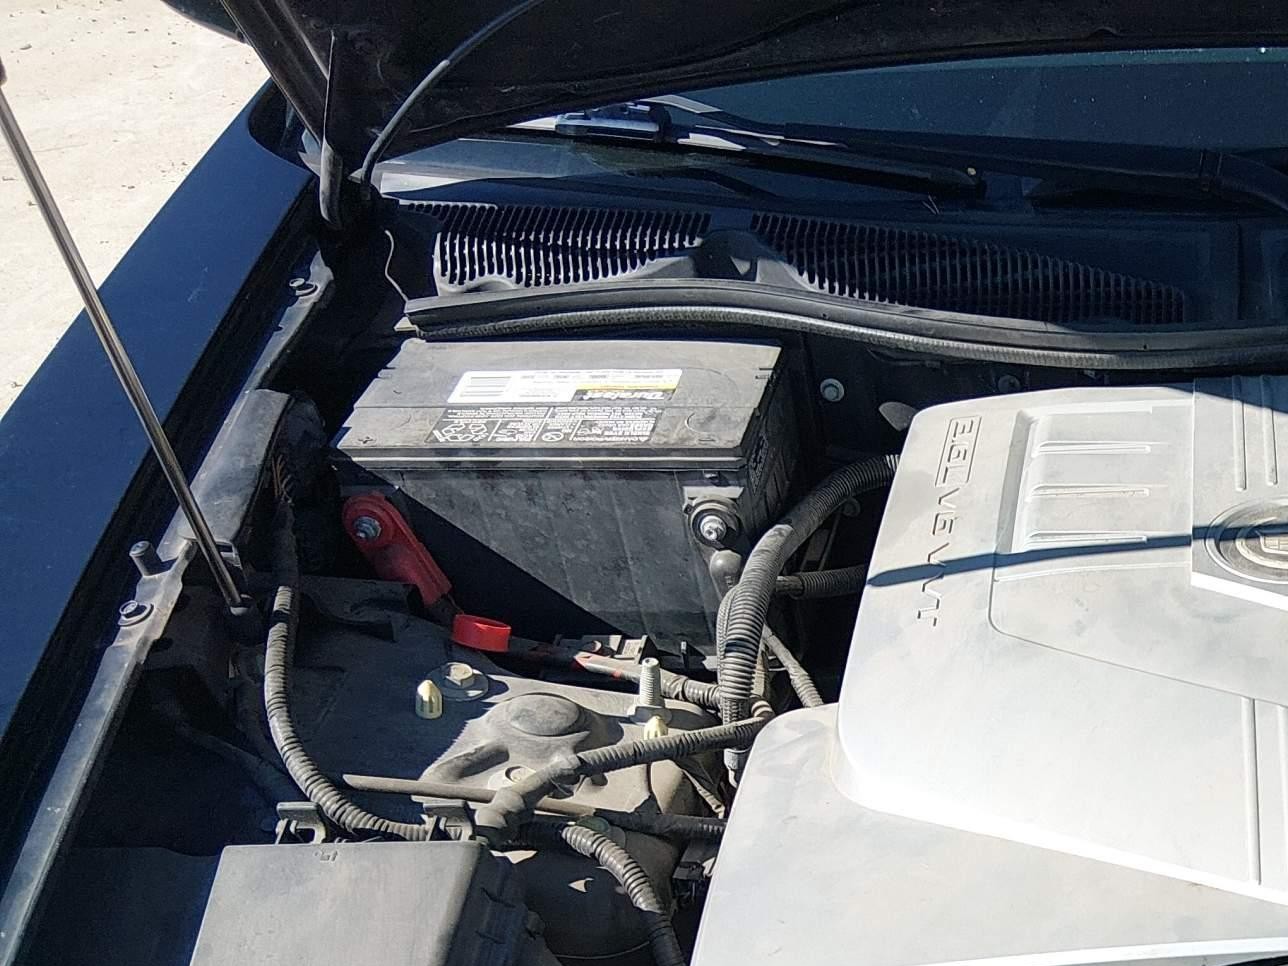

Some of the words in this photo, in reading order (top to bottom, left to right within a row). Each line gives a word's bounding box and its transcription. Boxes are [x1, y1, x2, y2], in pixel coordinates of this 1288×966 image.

[942, 419, 974, 485] 3.6L
[931, 487, 961, 537] V6
[916, 541, 950, 628] VVT
